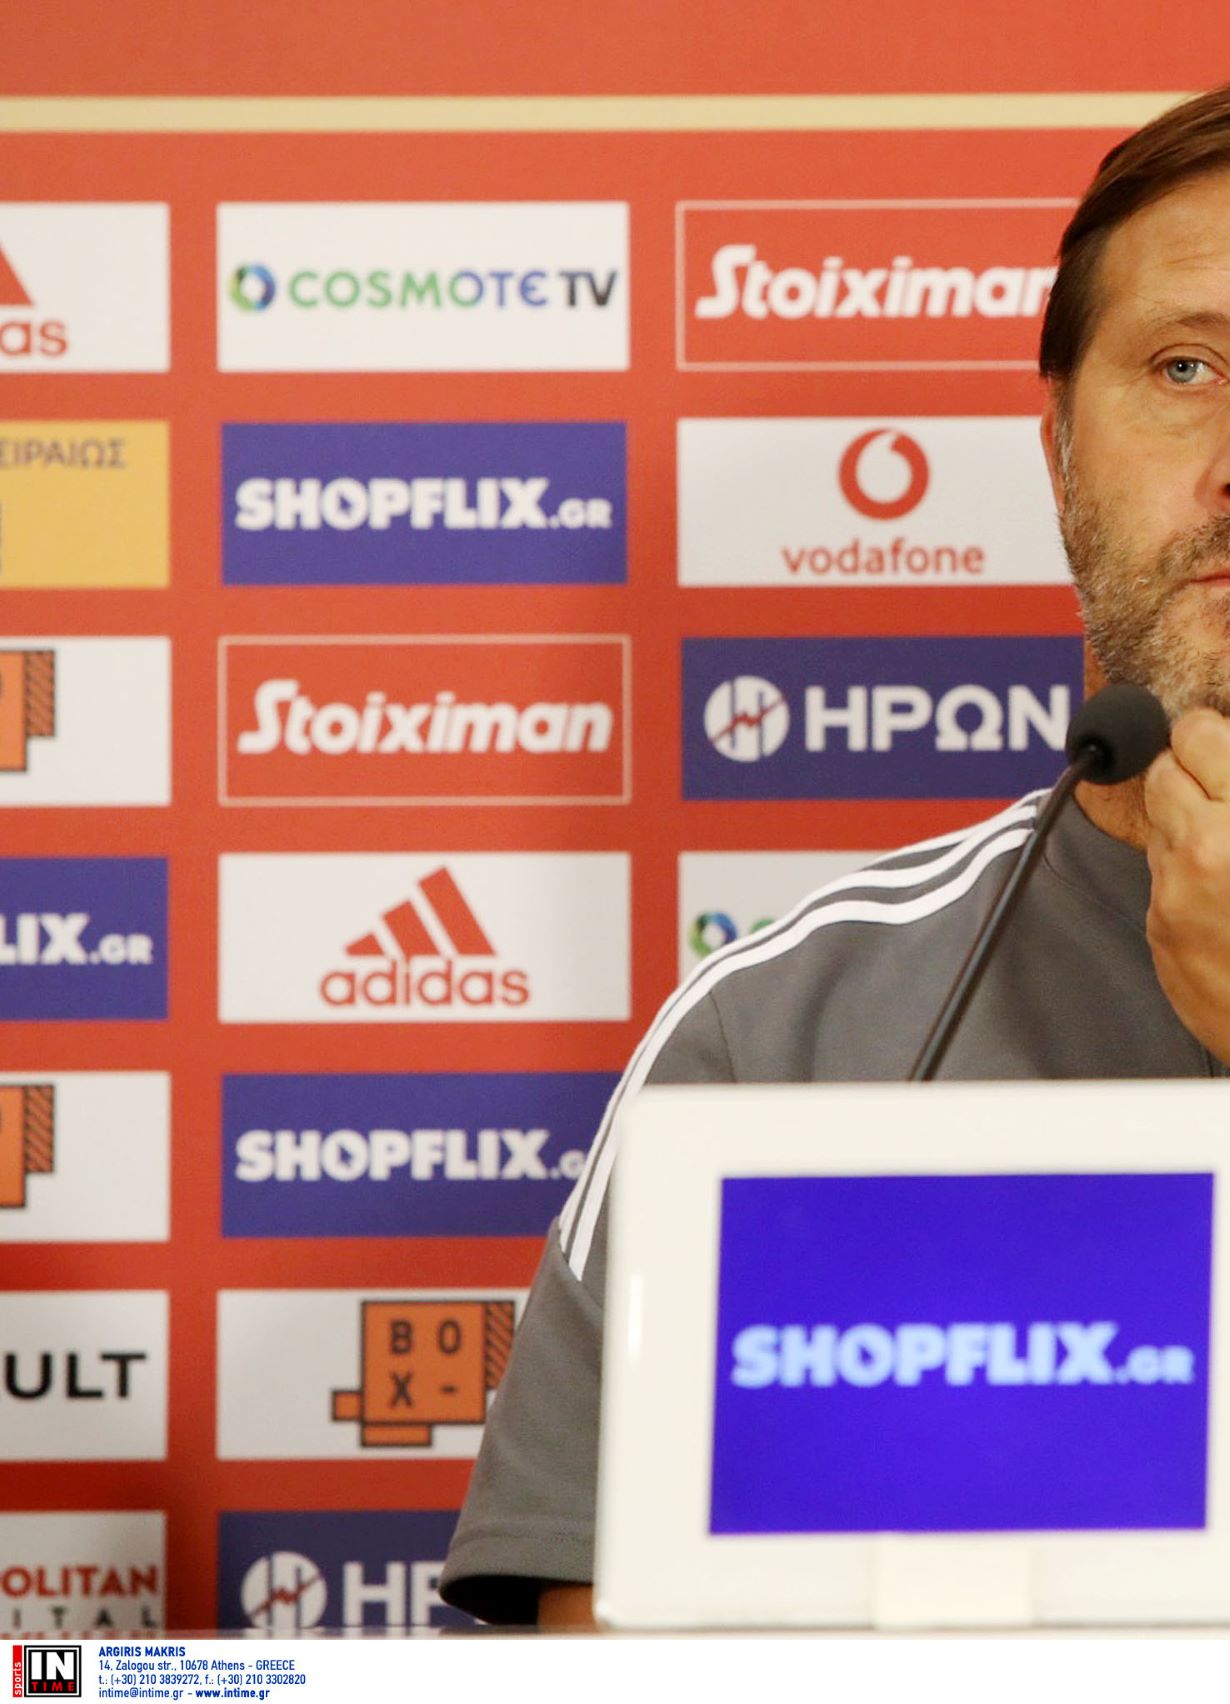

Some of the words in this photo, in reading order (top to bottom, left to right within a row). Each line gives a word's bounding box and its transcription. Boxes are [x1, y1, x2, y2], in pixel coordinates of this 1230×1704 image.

[287, 269, 549, 309] COSMOTE
[560, 270, 618, 308] TV
[235, 477, 612, 531] SHOPFLIX.GR
[781, 536, 986, 576] vodafone
[237, 679, 612, 755] Stoiximan
[319, 960, 531, 1007] adidas
[235, 1129, 586, 1181] SHOPFLIX.G
[731, 1321, 1195, 1388] SHOPFLIX.GR
